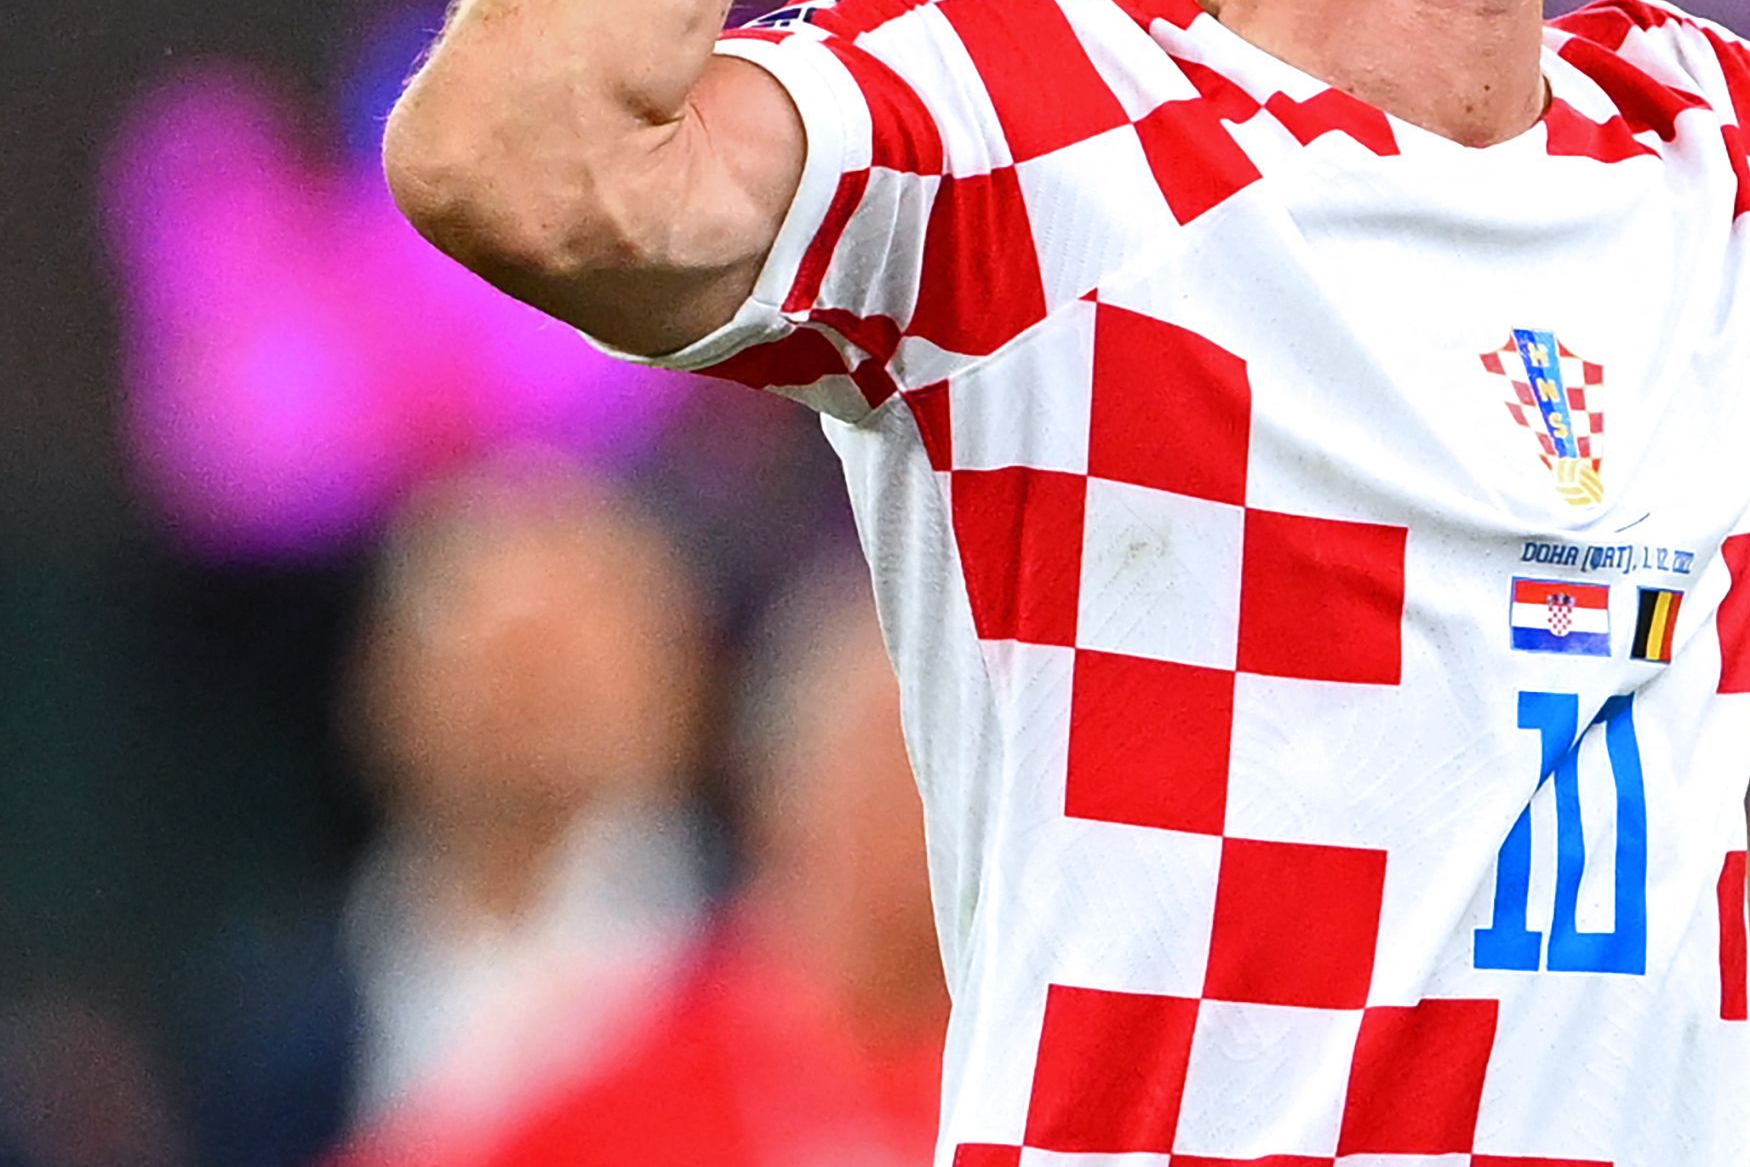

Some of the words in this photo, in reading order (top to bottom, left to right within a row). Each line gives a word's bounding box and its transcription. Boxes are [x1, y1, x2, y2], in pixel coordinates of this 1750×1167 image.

[1526, 341, 1569, 439] HNS
[1521, 542, 1579, 566] DOHA
[1474, 690, 1647, 975] 10
